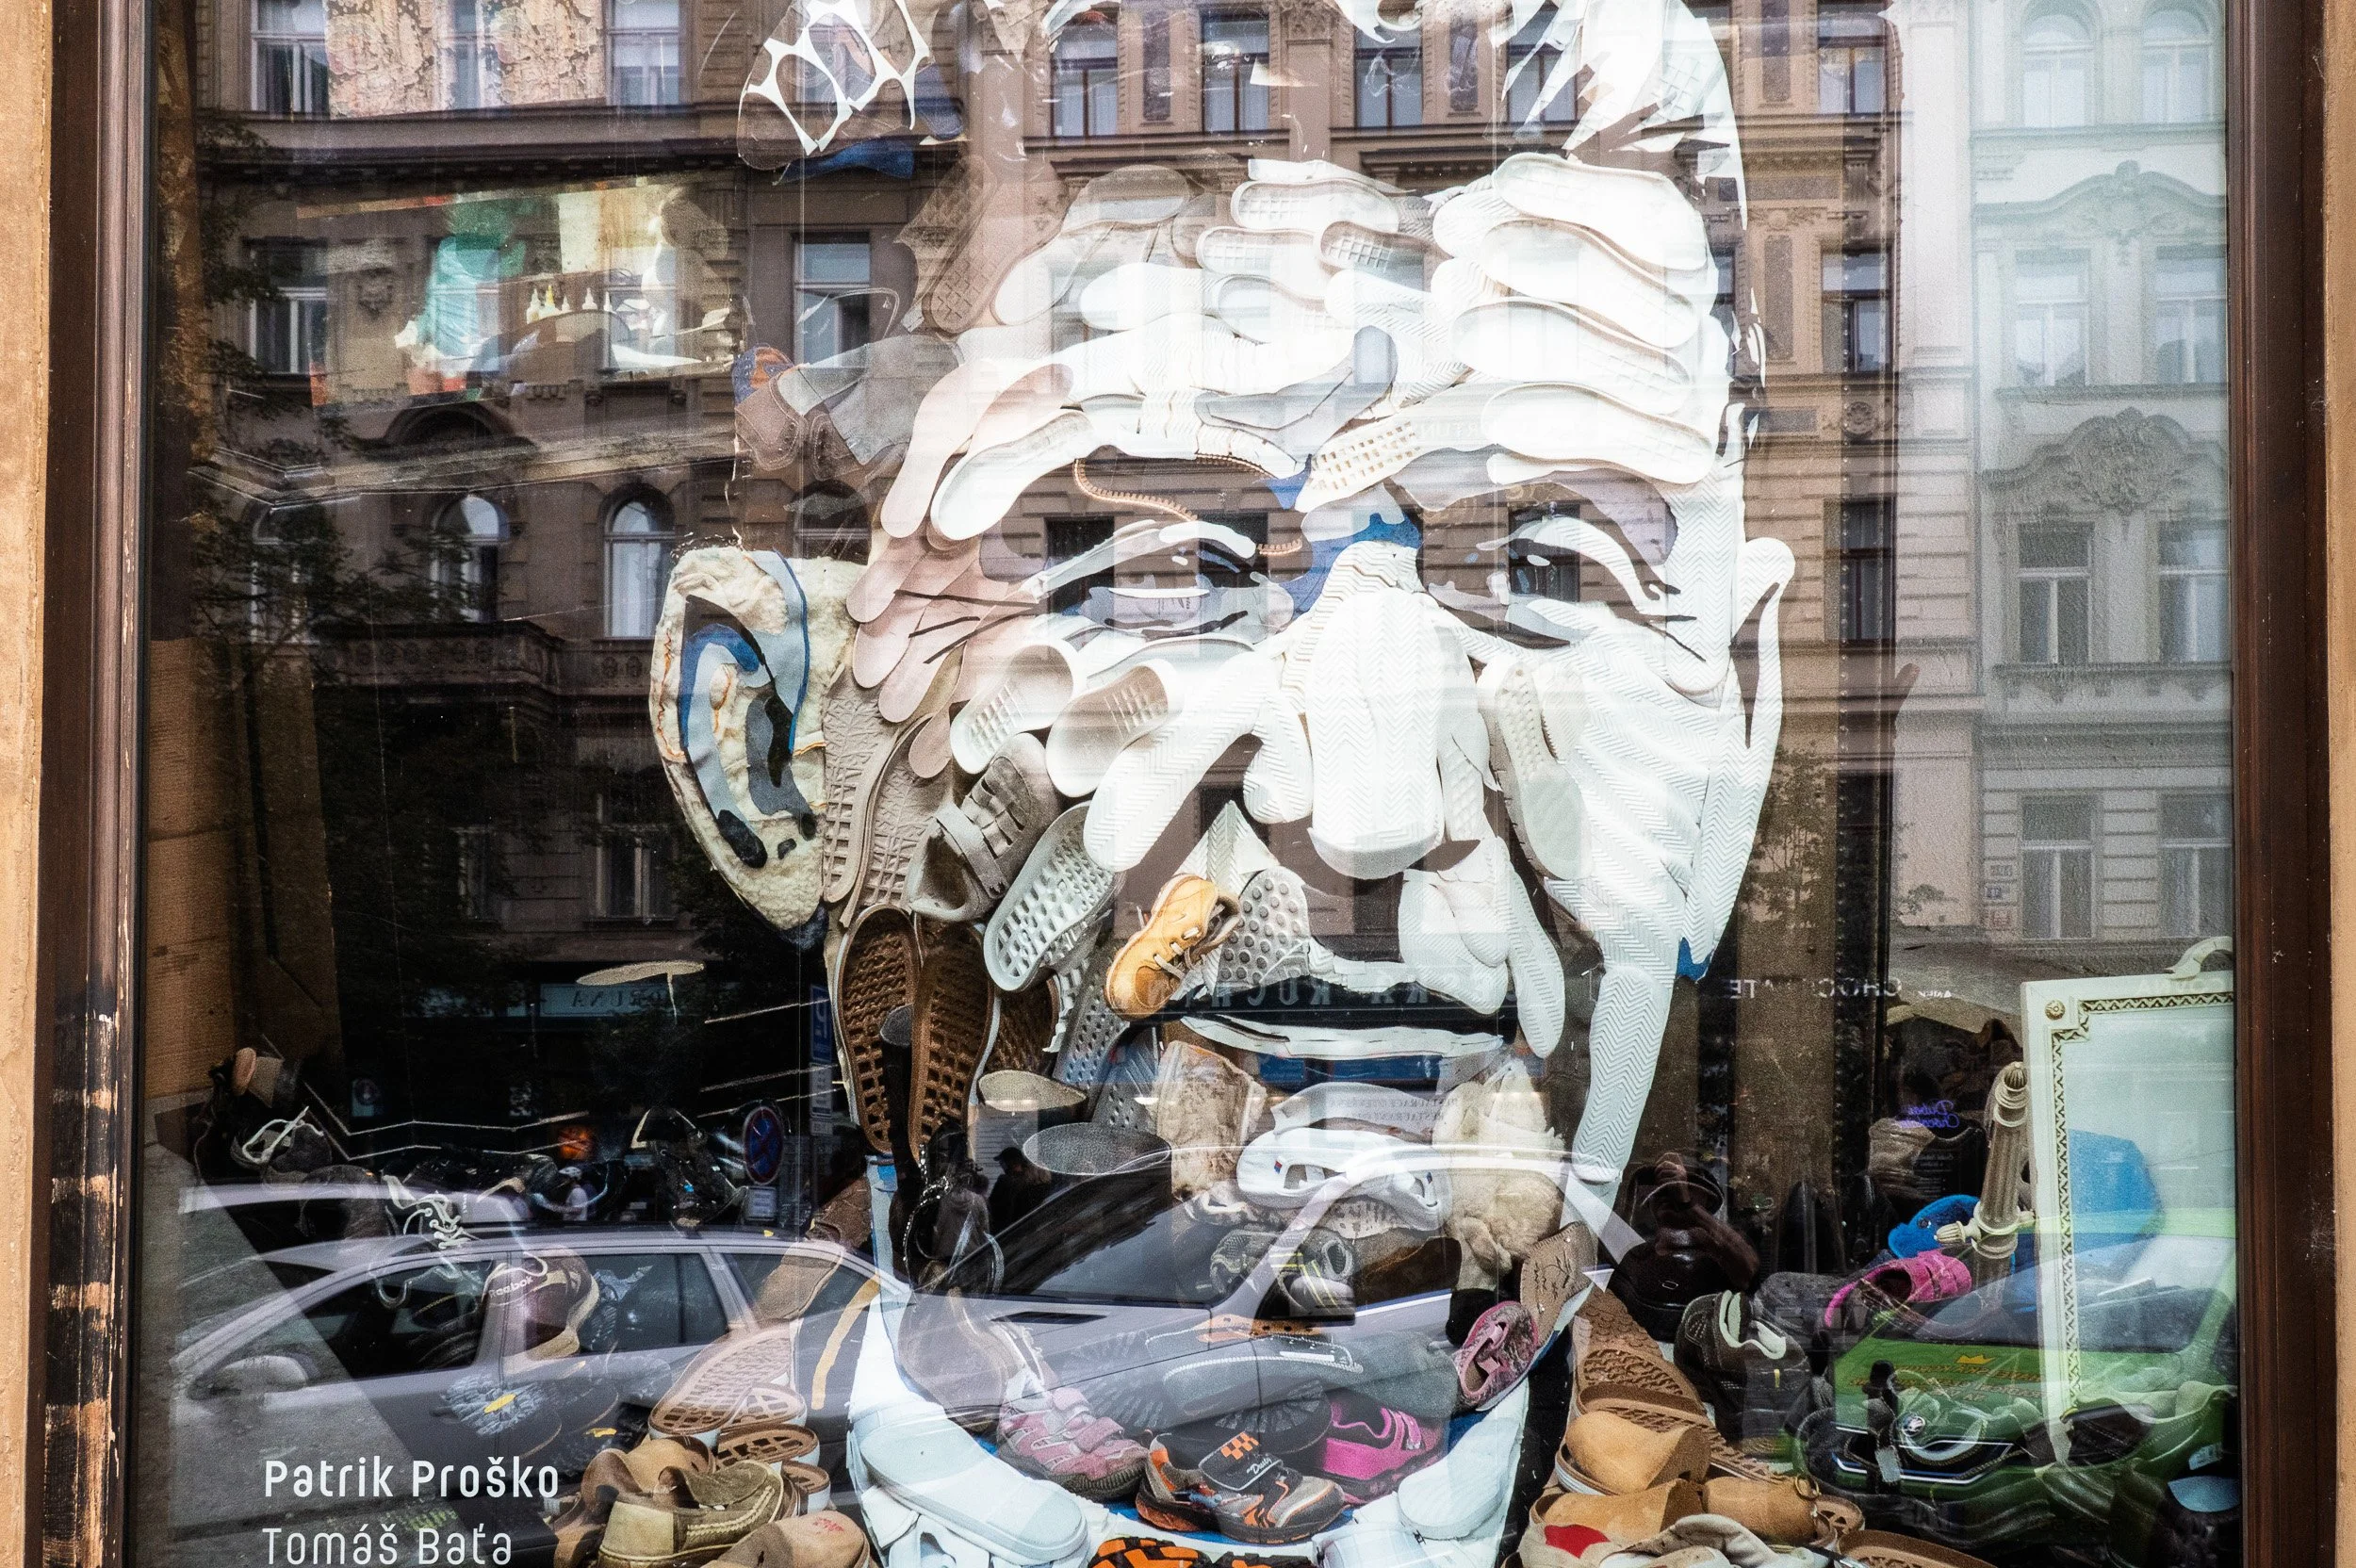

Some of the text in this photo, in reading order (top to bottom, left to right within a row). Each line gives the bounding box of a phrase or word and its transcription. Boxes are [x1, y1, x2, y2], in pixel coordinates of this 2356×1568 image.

[488, 1275, 533, 1298] Reebok
[265, 1456, 559, 1498] Patrik Proško
[262, 1523, 512, 1565] Tomáš Baťa
